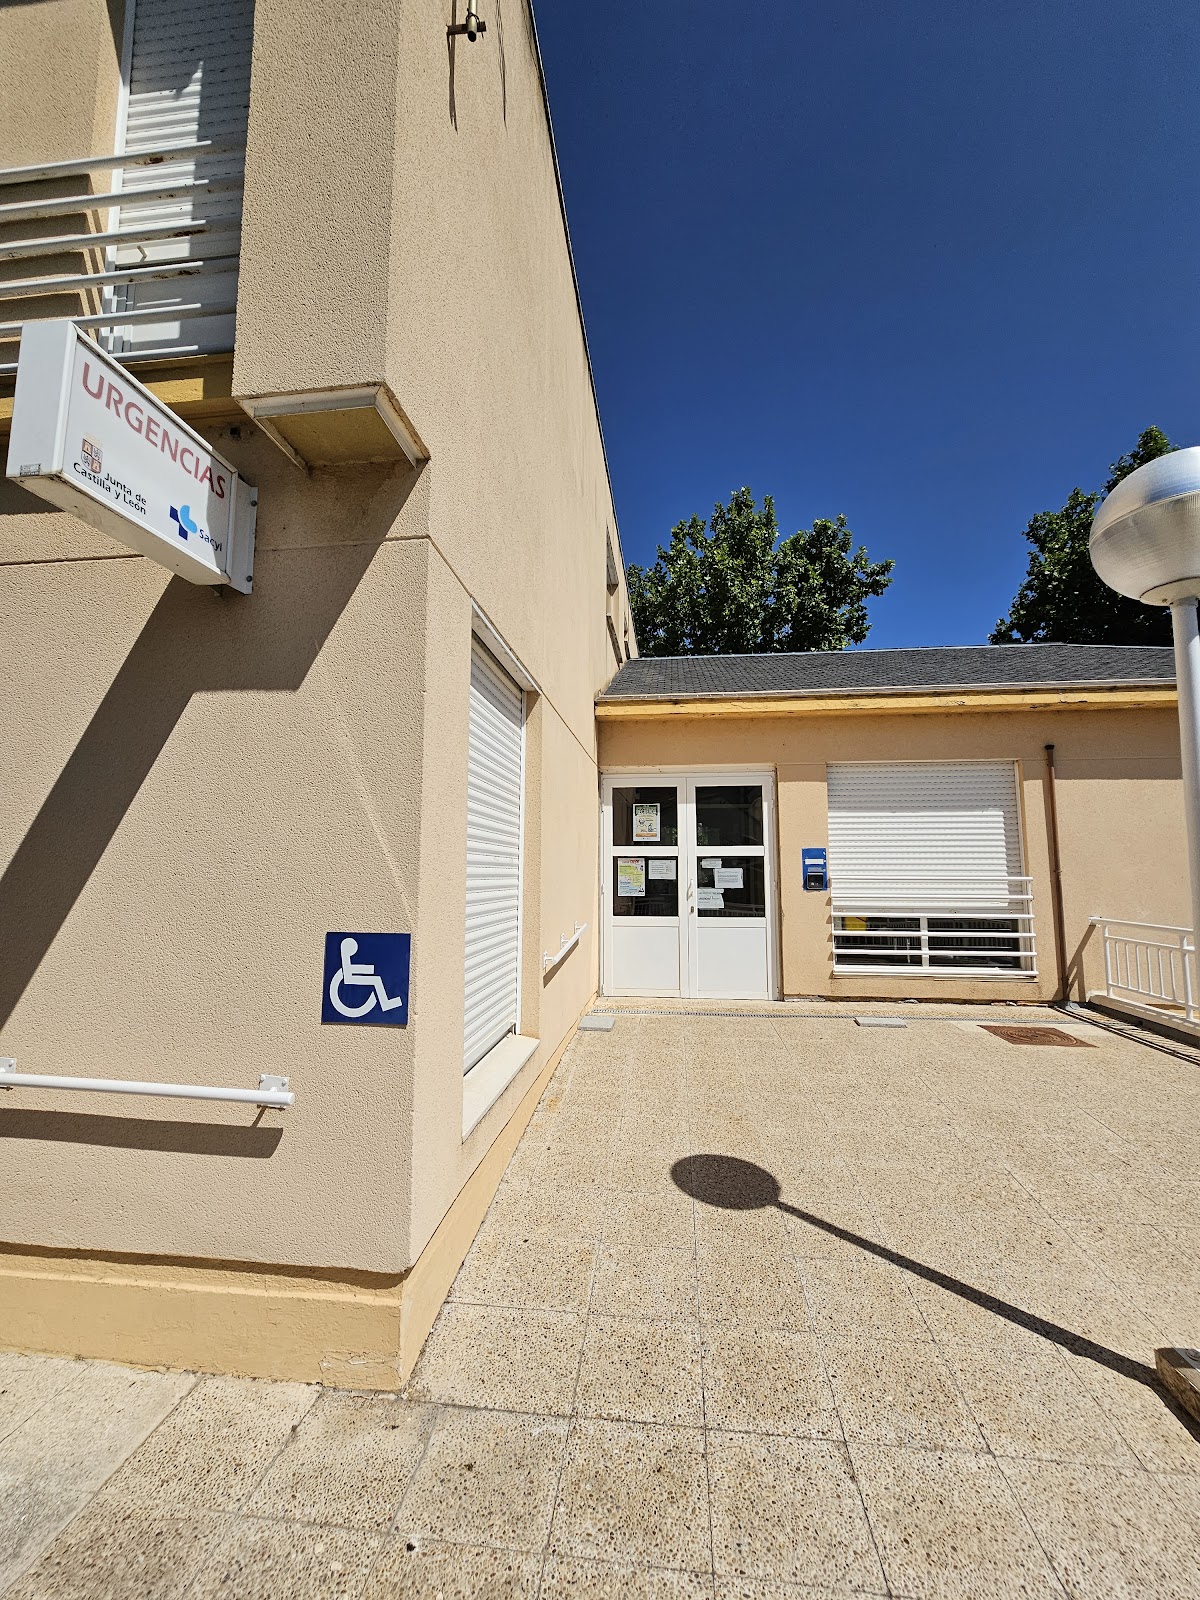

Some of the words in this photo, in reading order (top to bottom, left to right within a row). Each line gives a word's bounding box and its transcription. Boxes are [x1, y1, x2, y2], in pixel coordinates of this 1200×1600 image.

[82, 361, 226, 500] URGENCIAS
[73, 462, 111, 493] Castilla
[114, 490, 121, 500] y
[123, 493, 146, 515] León
[104, 472, 132, 497] Junta
[135, 491, 147, 505] de
[199, 529, 223, 552] sacyl
